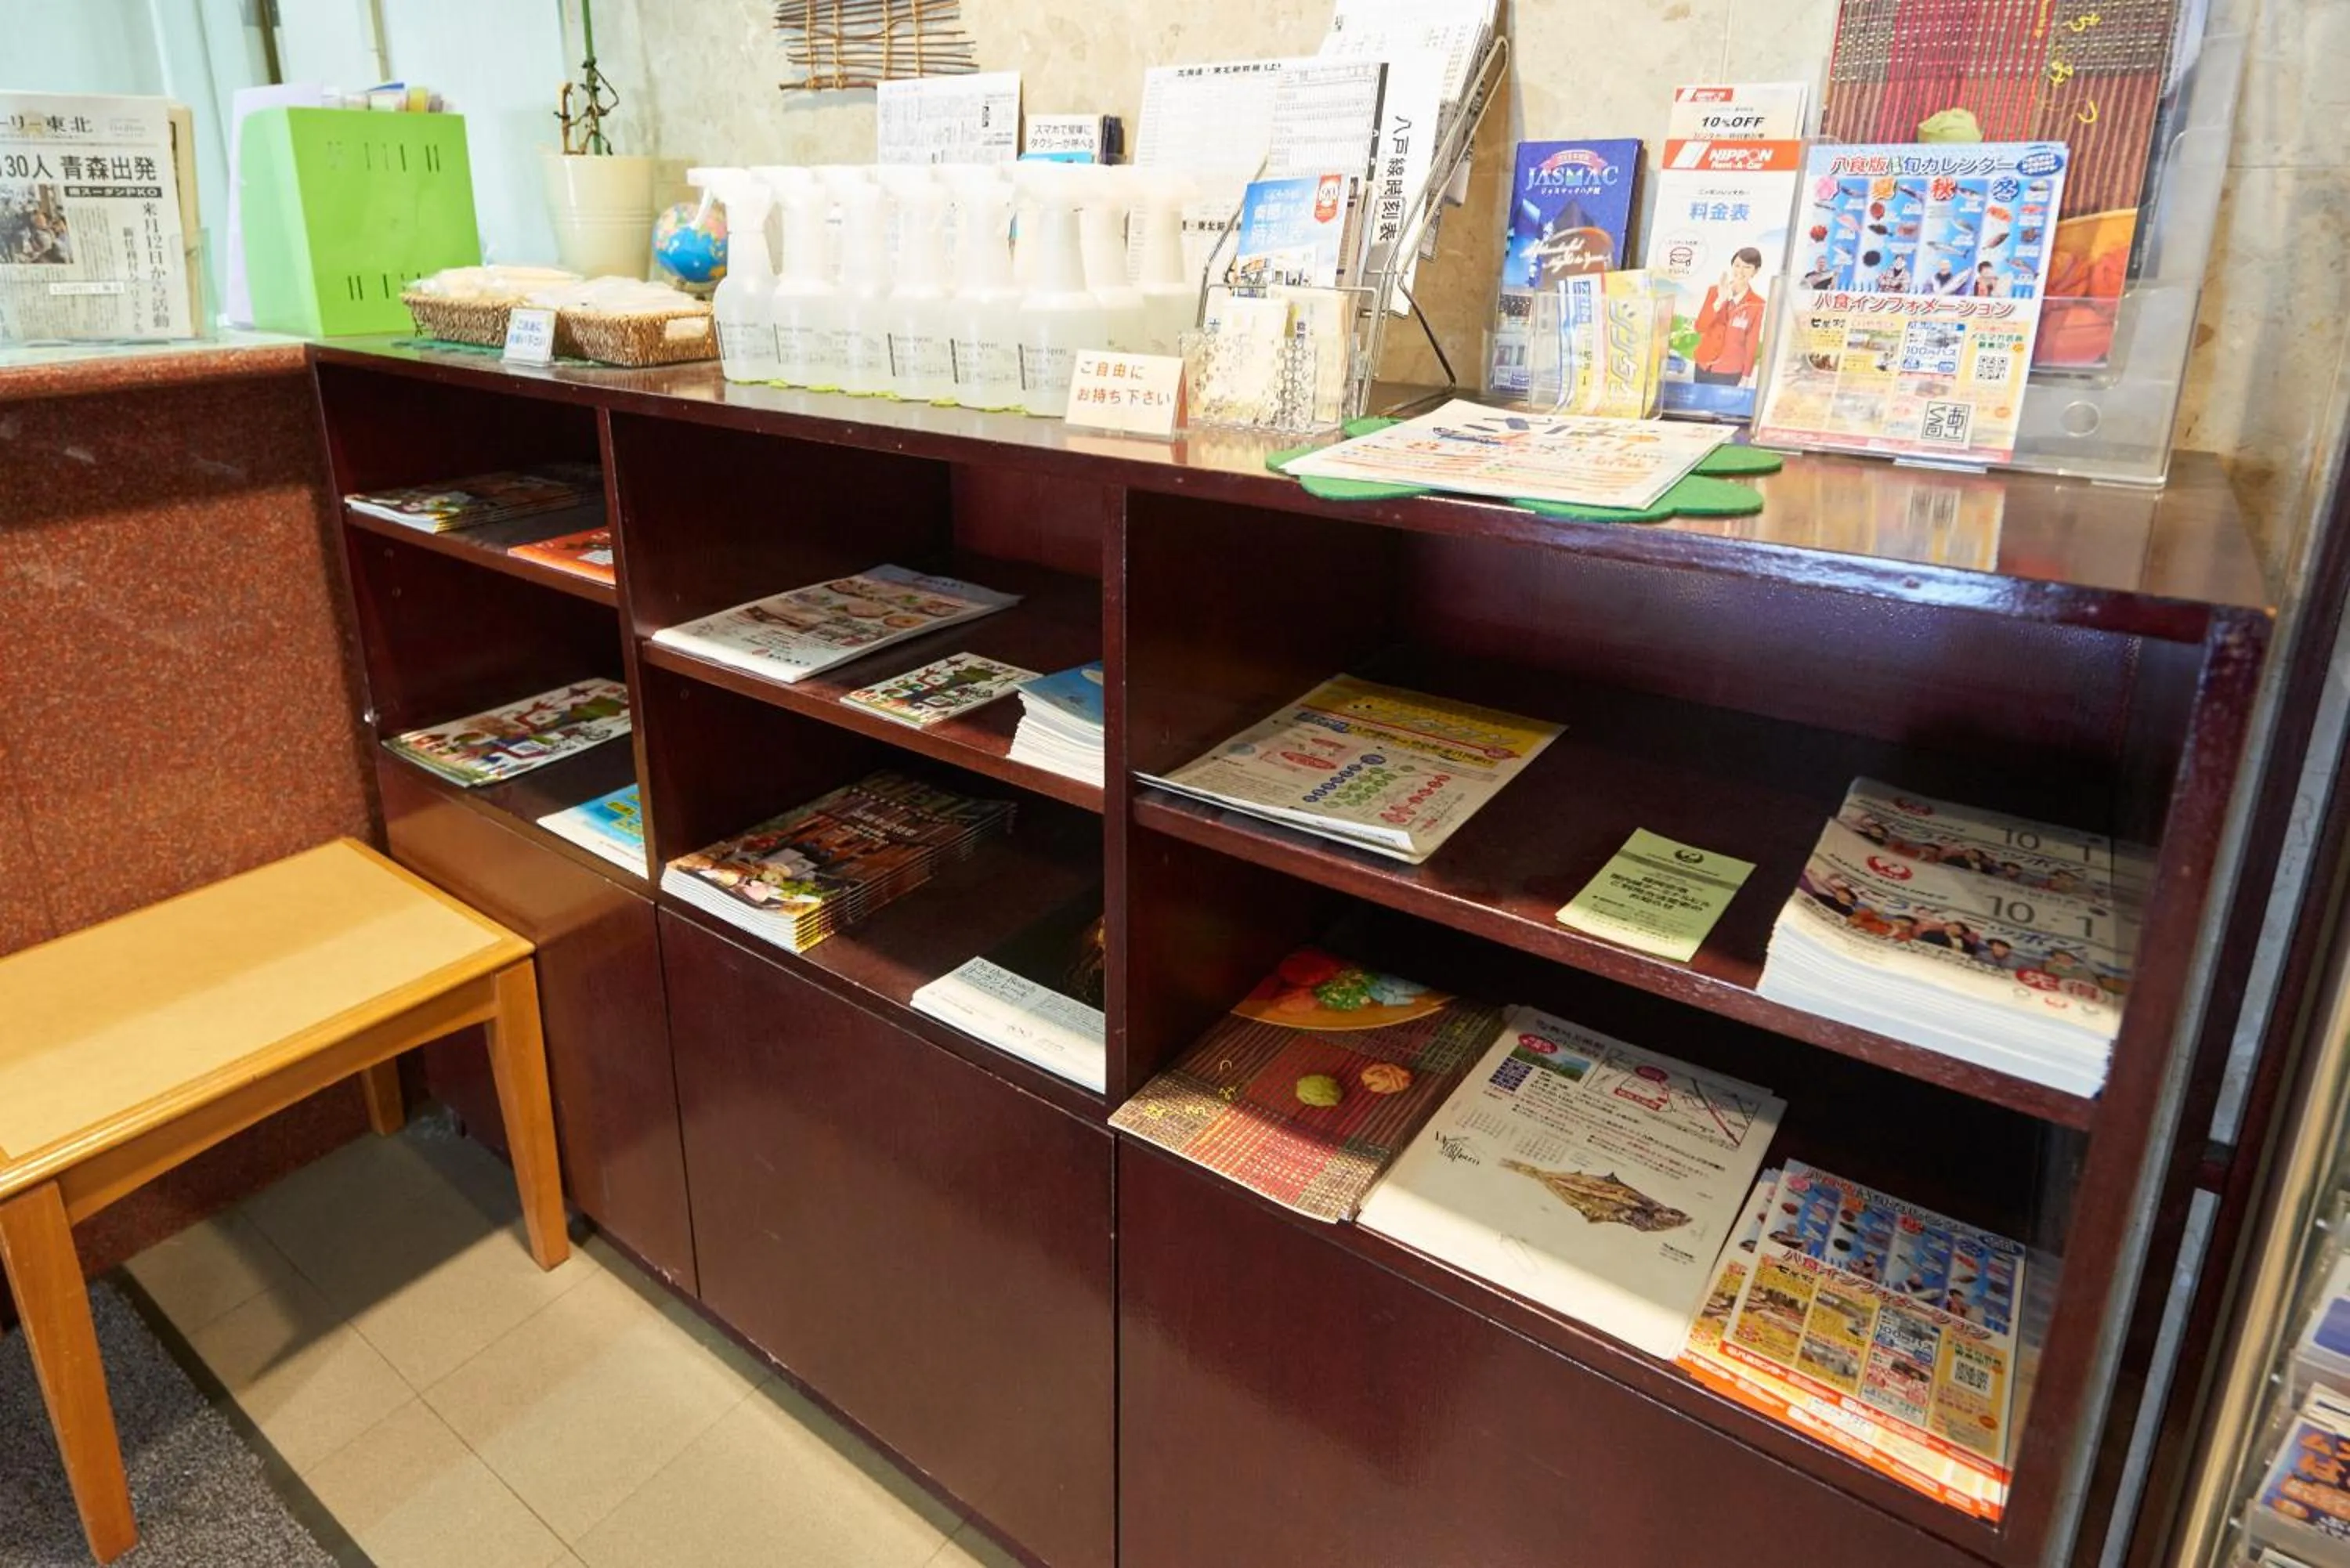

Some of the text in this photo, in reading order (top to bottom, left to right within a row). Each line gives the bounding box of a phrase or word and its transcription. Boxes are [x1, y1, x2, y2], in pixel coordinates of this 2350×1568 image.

[60, 155, 157, 181] 青森出発
[1526, 165, 1619, 190] JASMAC
[1690, 202, 1751, 222] 料金表
[1813, 292, 2017, 319] 八食インフォメーション
[1079, 359, 1145, 381] ご自由に
[1076, 387, 1171, 407] お持ち下さい
[2002, 826, 2041, 851] 10
[1988, 894, 2035, 926] 10
[2077, 916, 2093, 939] 1
